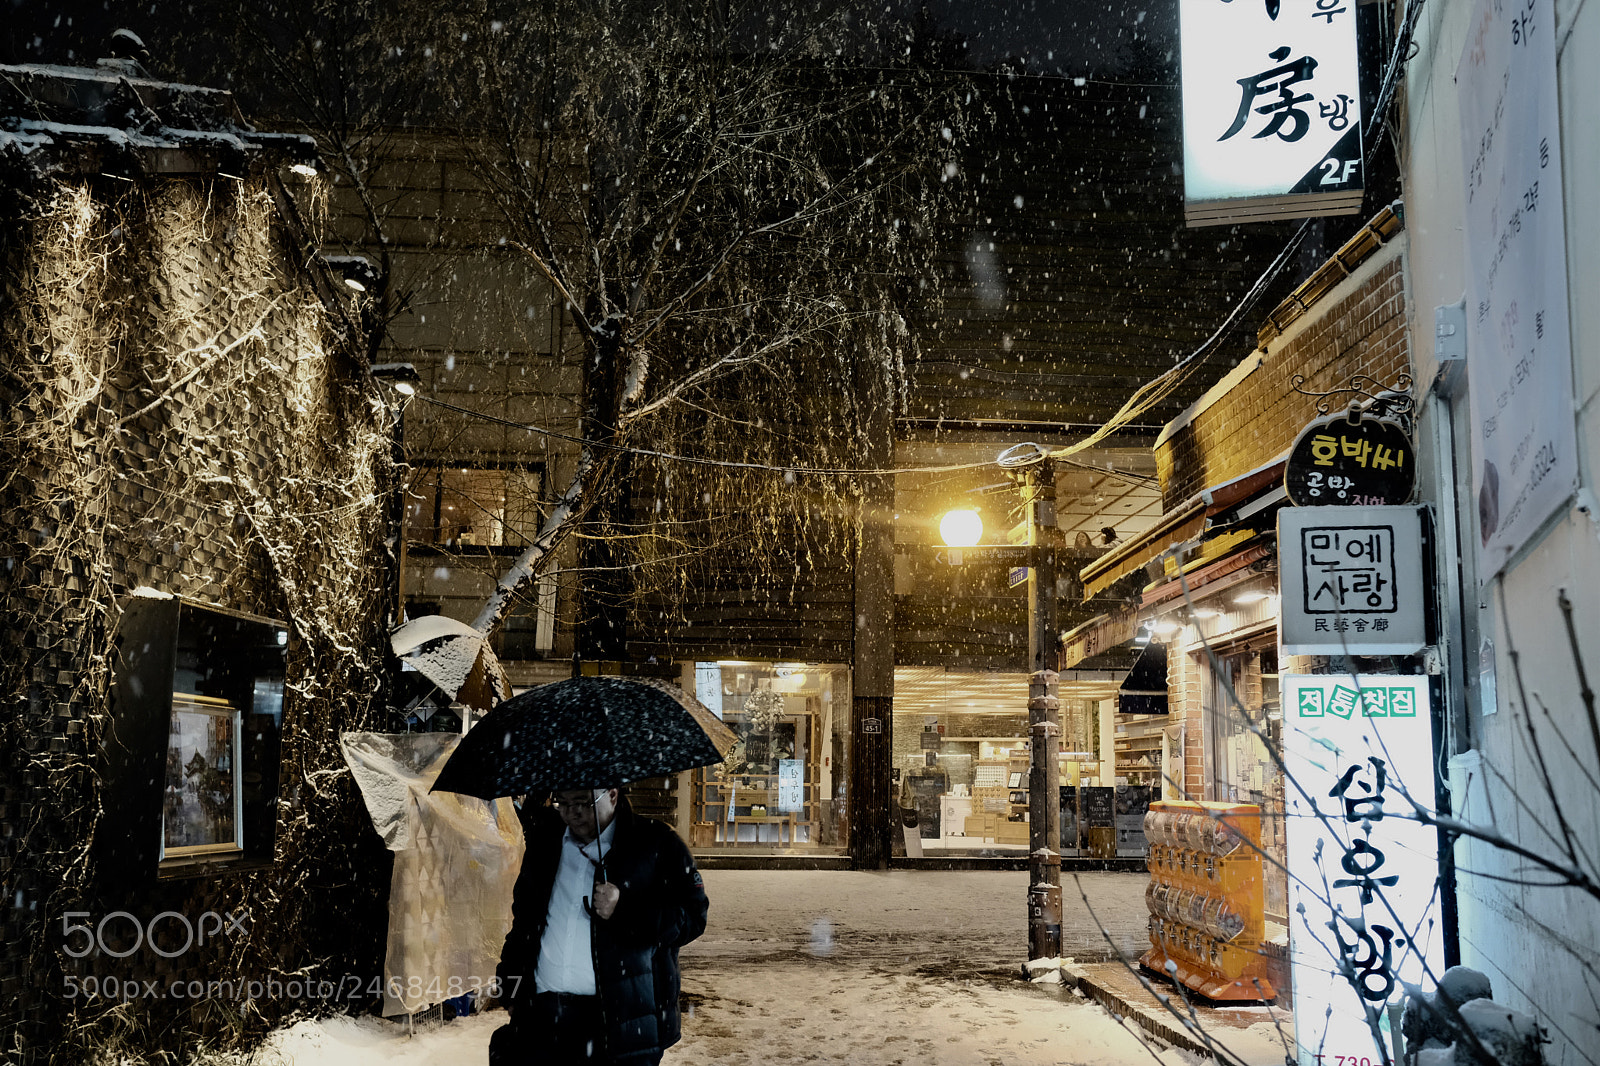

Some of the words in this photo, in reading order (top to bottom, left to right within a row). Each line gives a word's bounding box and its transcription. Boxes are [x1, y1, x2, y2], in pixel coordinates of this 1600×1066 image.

[1217, 0, 1319, 142] 房
[1319, 157, 1362, 186] 2F
[1311, 434, 1404, 471] 호박씨
[1307, 471, 1355, 498] 공방
[1310, 533, 1381, 566] 민예
[1314, 573, 1387, 607] 사랑
[1299, 686, 1416, 718] 전통찻집
[1329, 756, 1406, 1001] 심우방
